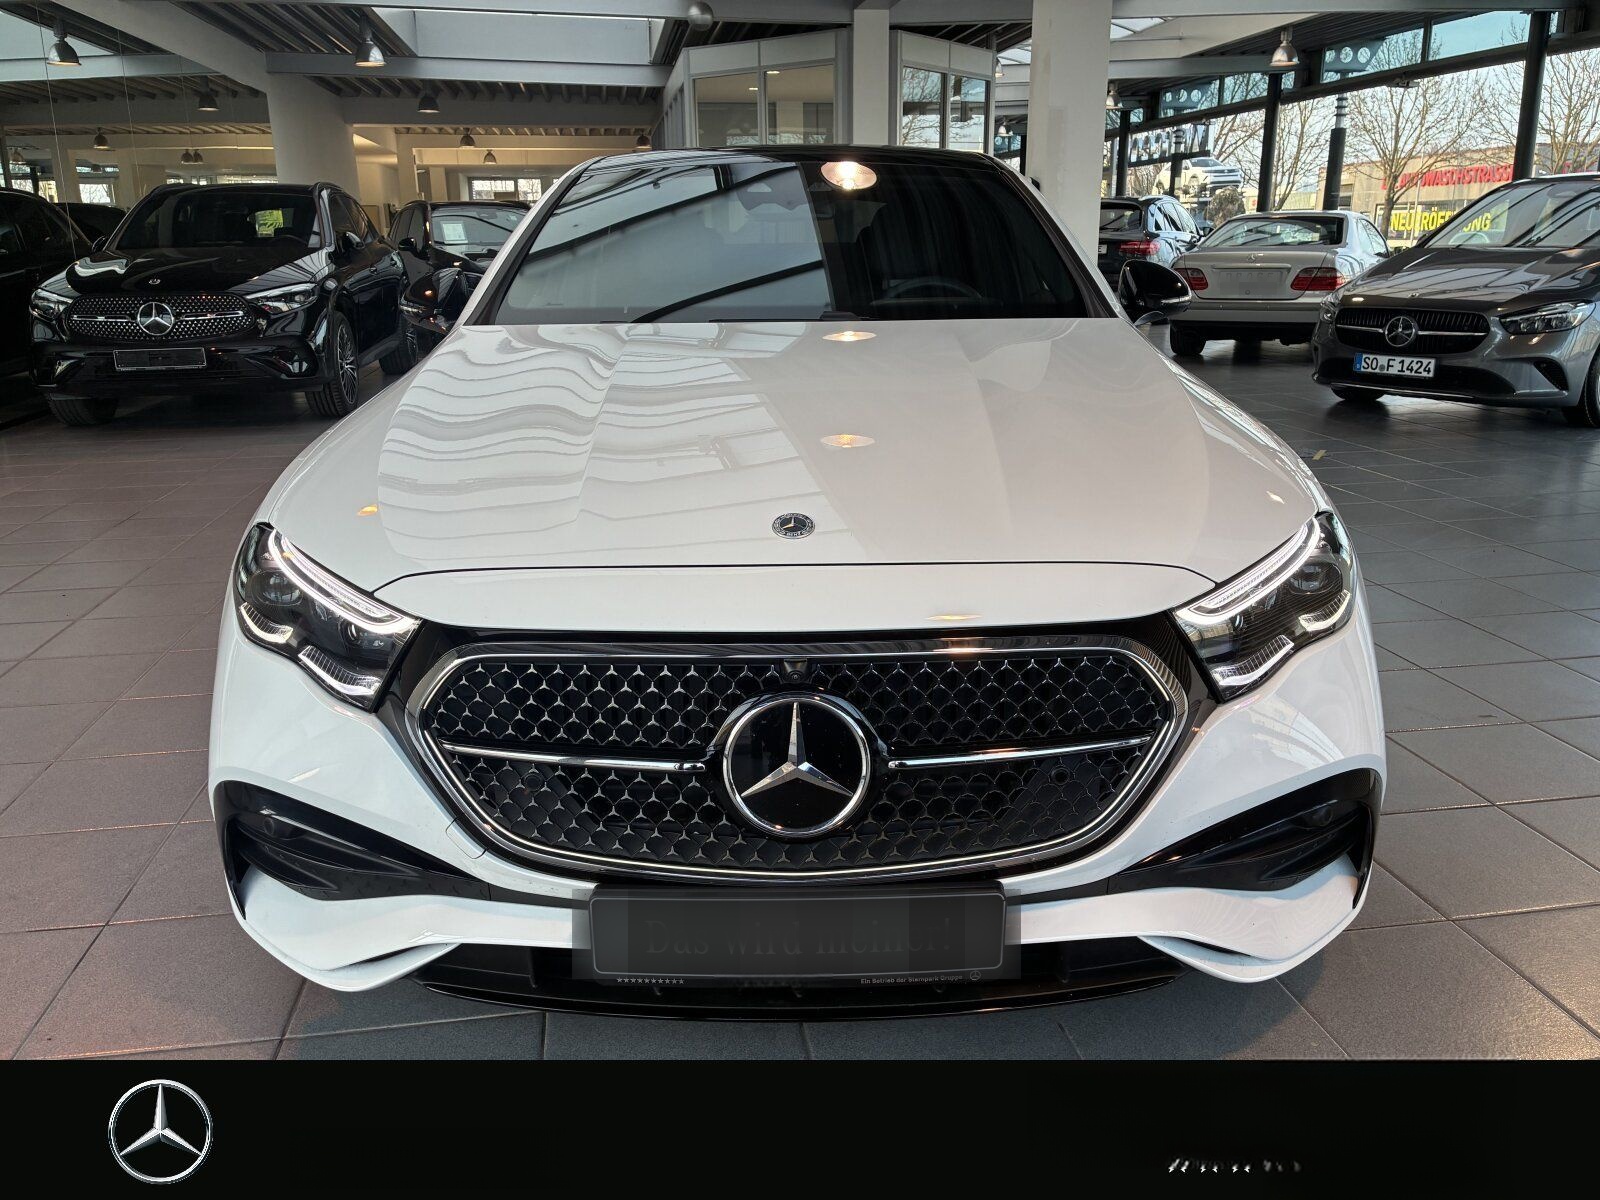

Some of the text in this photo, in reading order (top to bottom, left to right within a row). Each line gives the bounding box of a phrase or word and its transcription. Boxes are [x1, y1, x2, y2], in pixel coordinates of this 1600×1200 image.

[1390, 207, 1492, 231] NEURÖFUNG
[1362, 356, 1432, 375] SO F 1424
[643, 919, 710, 955] Das
[726, 920, 804, 955] wird
